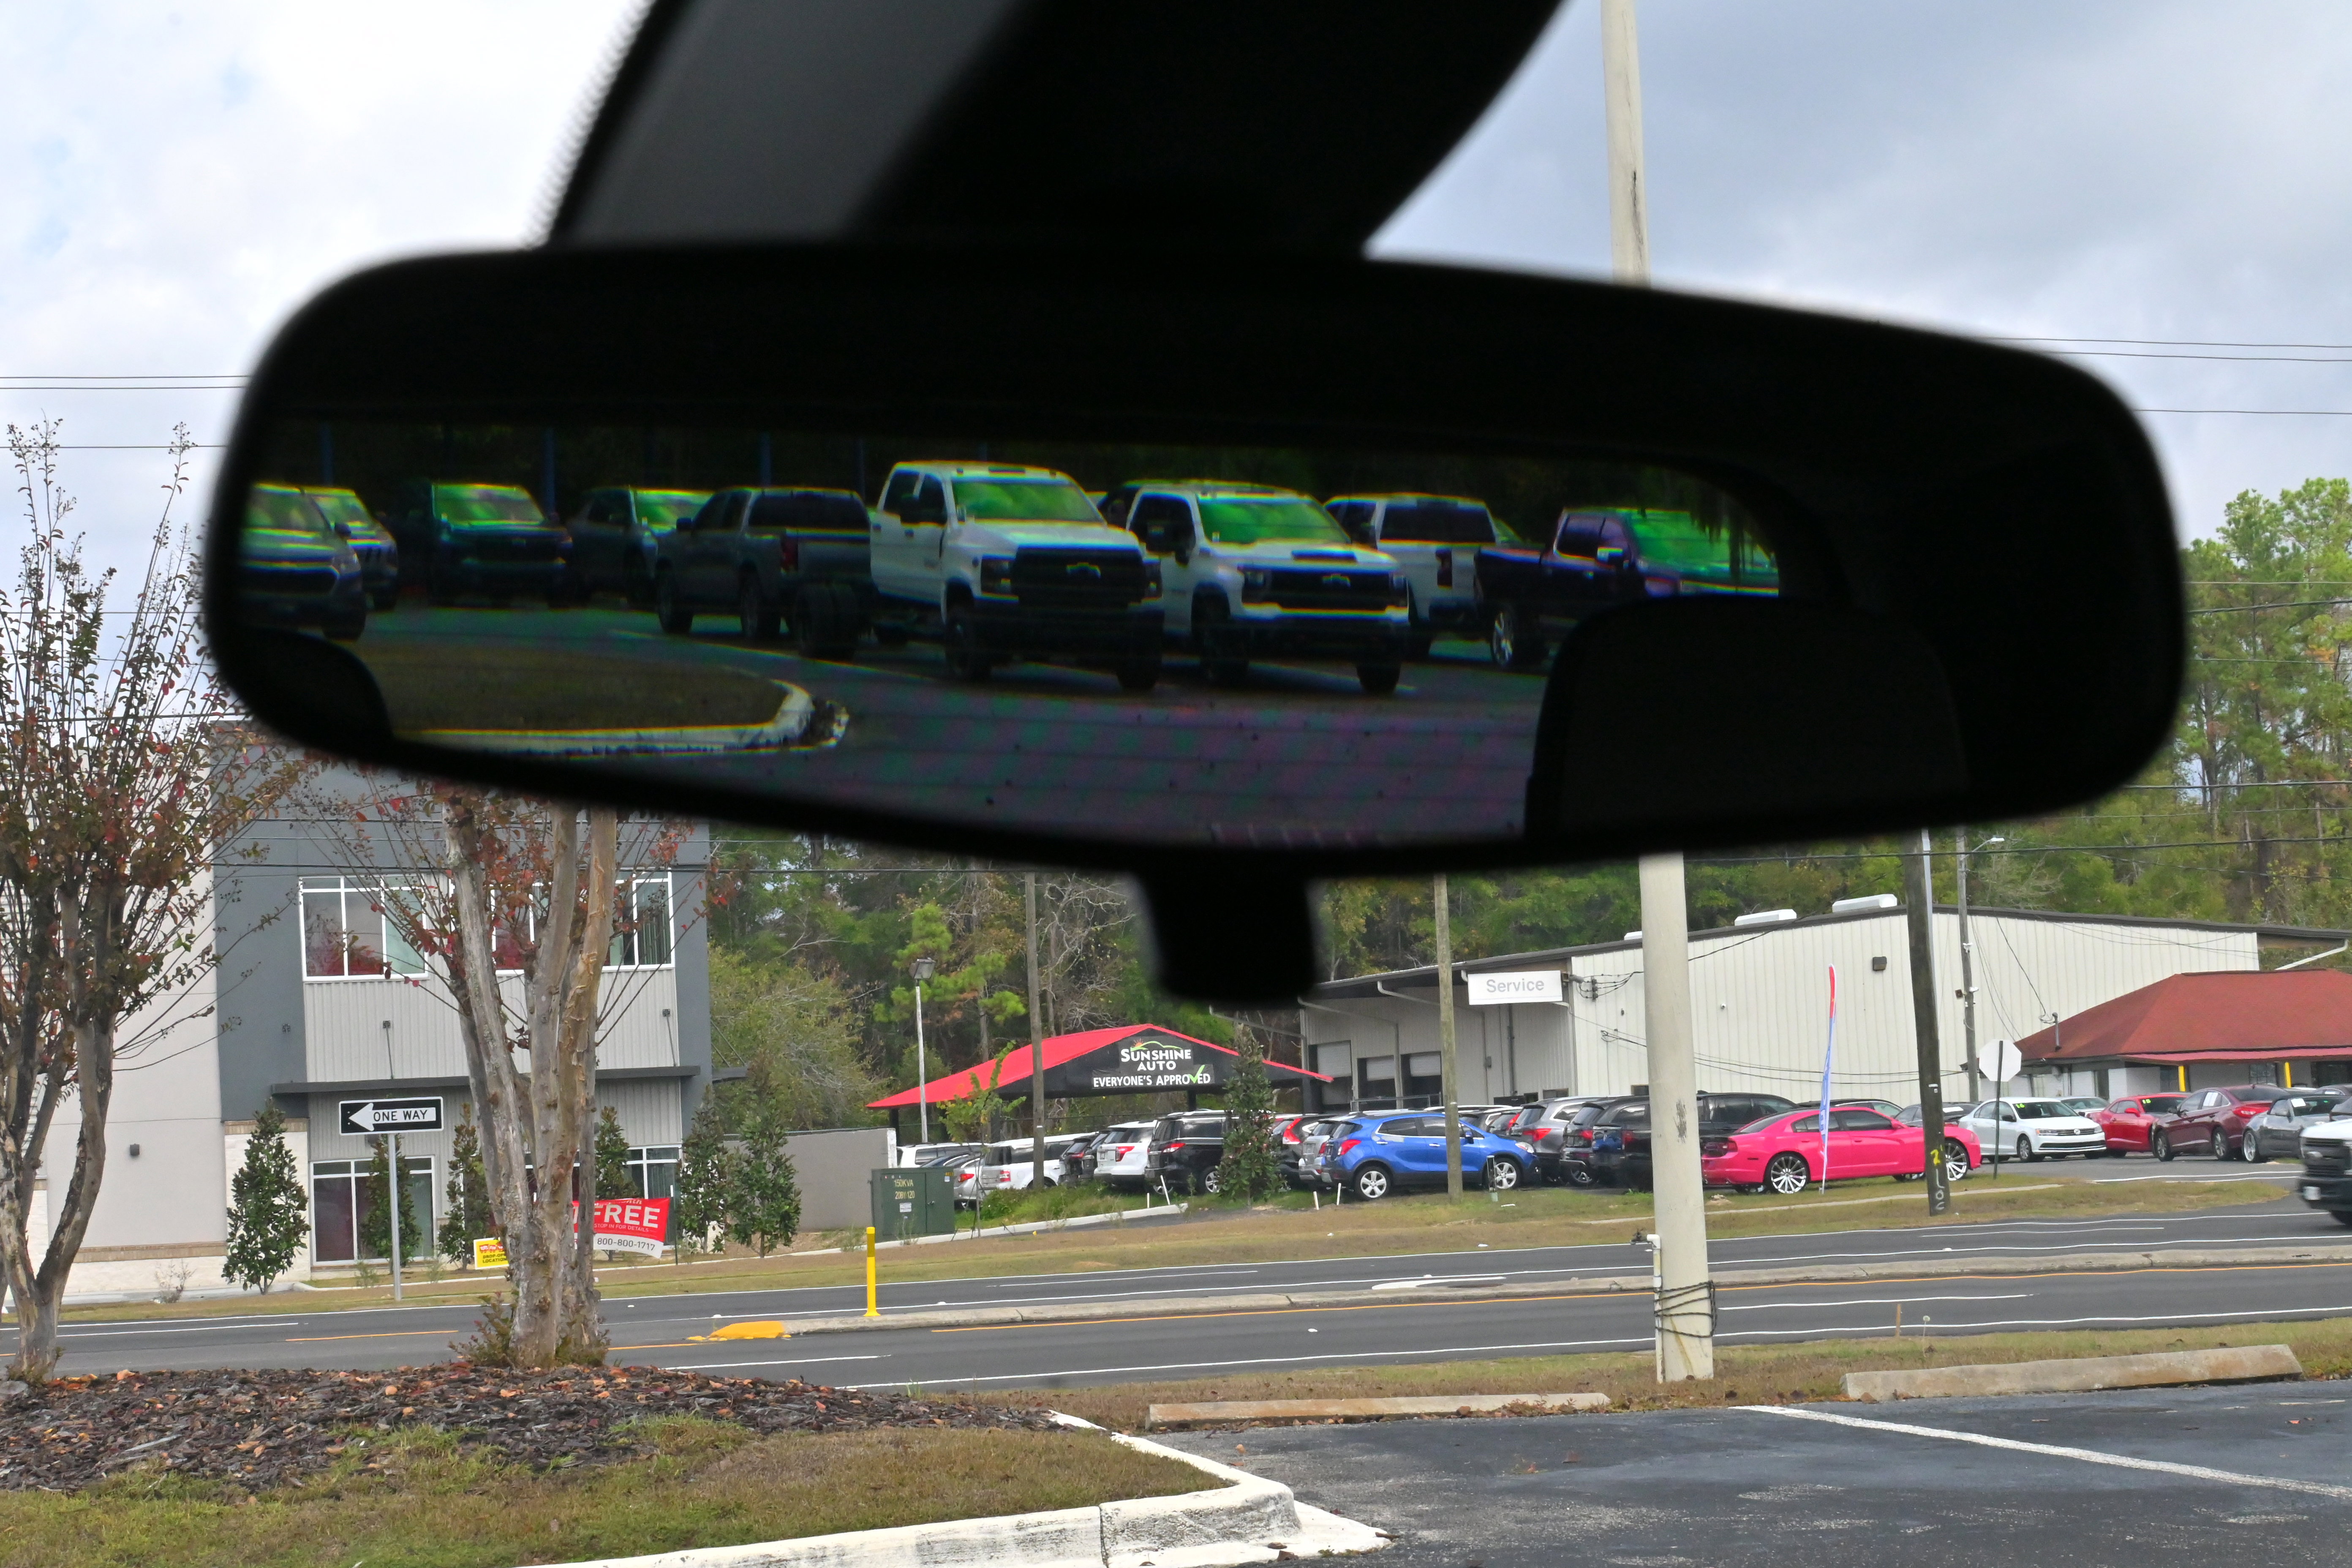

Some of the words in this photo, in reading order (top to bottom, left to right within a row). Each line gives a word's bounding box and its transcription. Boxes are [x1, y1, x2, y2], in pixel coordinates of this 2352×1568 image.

[1486, 978, 1544, 993] Service
[1137, 1060, 1176, 1071] AUTO
[1093, 1075, 1152, 1087] EVERYONE'S
[373, 1111, 397, 1122] ONE
[403, 1109, 427, 1121] WAY
[597, 1238, 655, 1251] 800-800-1717
